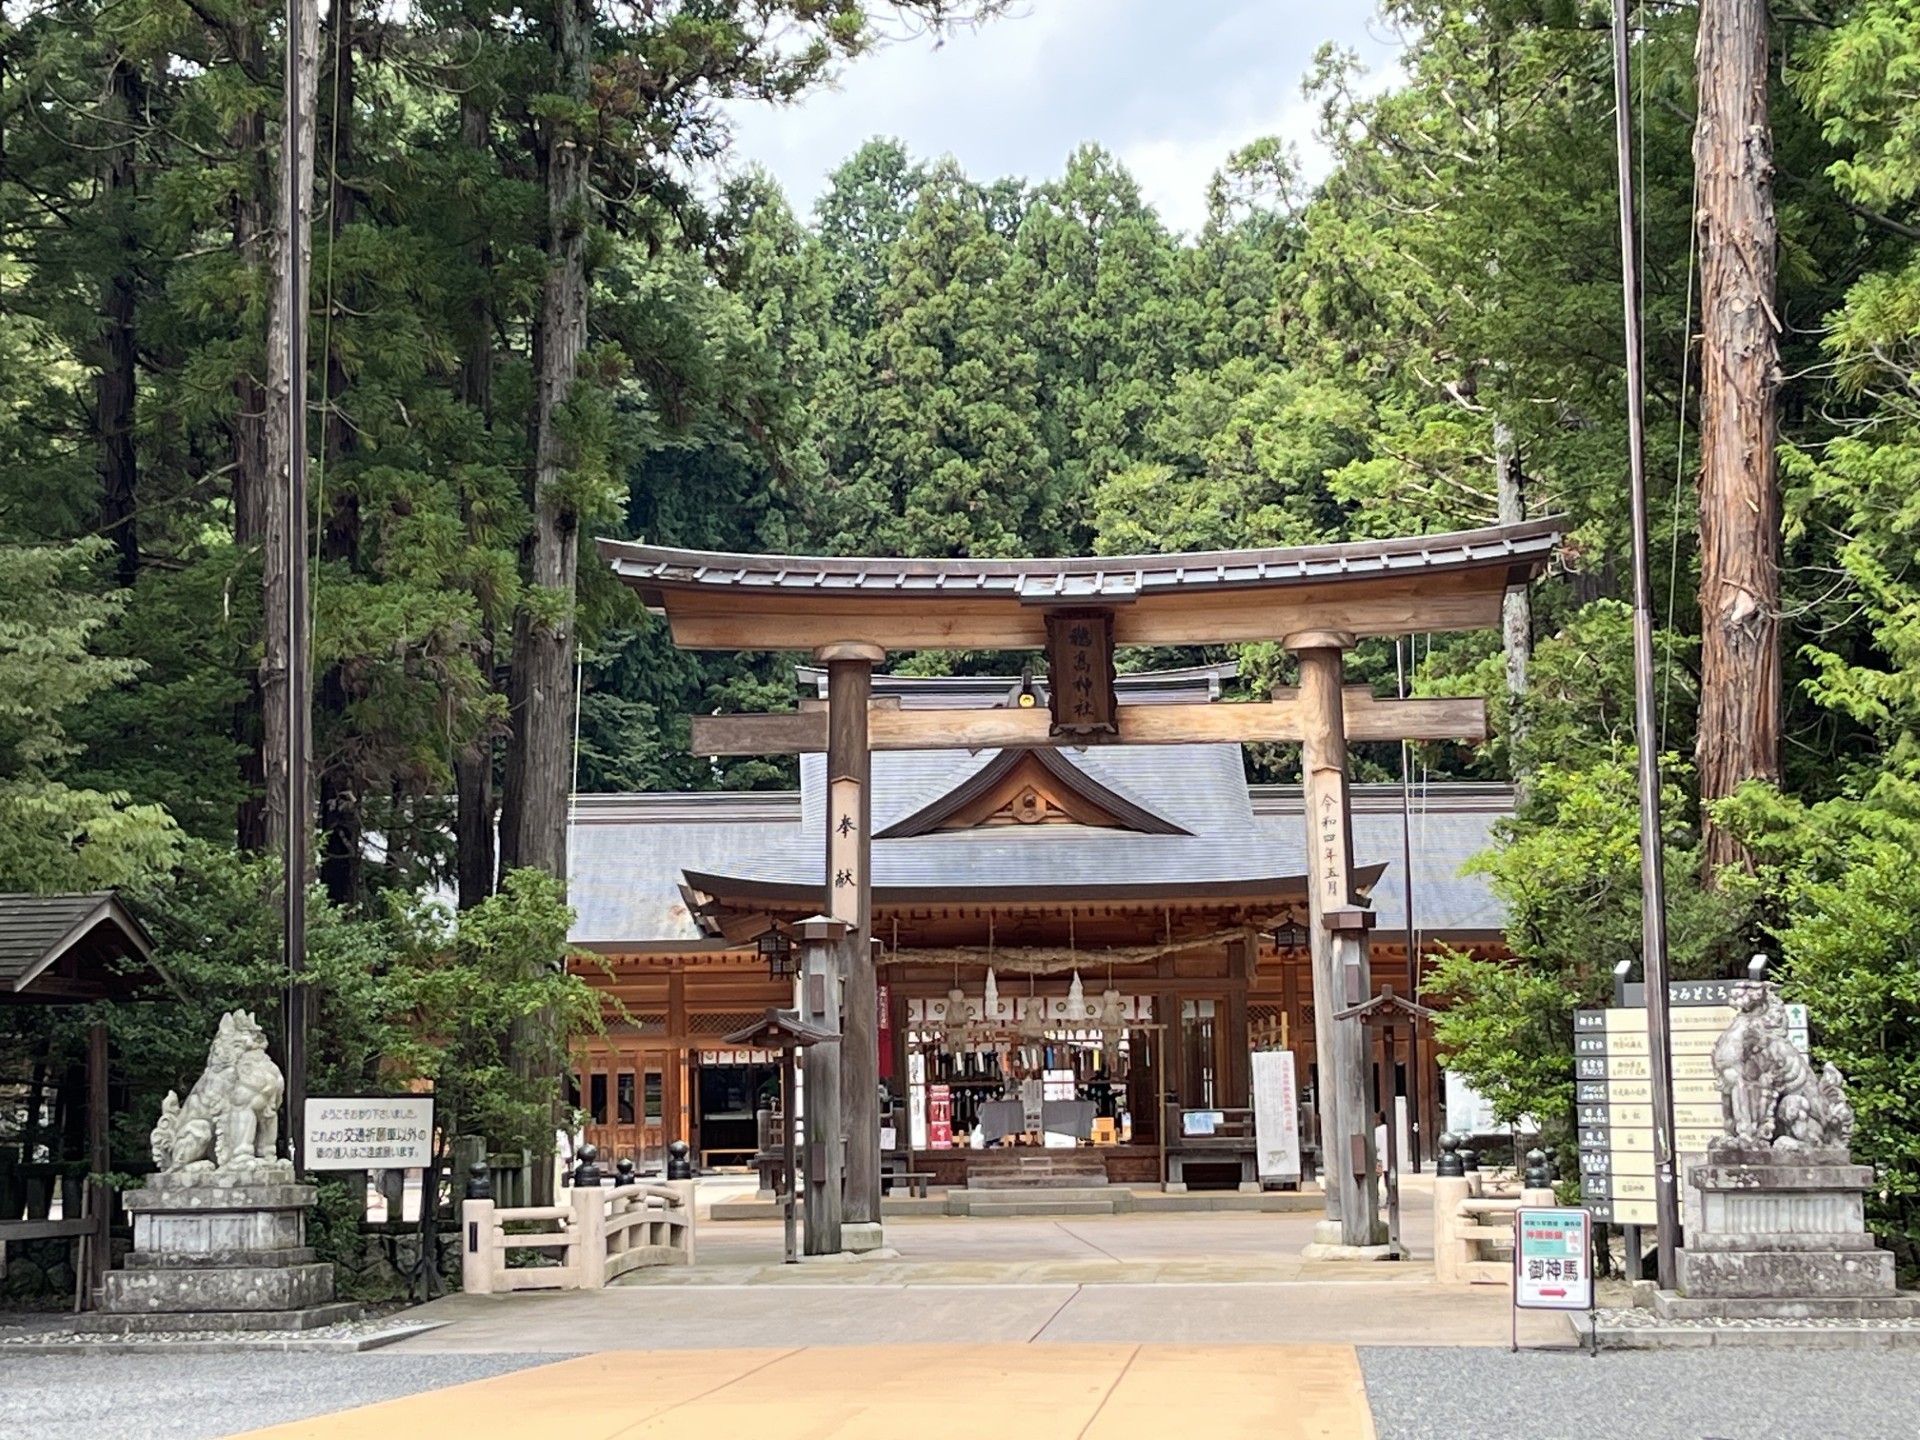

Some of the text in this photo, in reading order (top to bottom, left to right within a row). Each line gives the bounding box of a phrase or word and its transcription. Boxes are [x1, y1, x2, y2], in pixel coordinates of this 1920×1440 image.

[835, 813, 857, 888] 奉献
[1321, 793, 1340, 896] 令和四年五月
[311, 1127, 427, 1142] これより交通祈願車以外の
[1528, 1258, 1579, 1281] 御神馬
